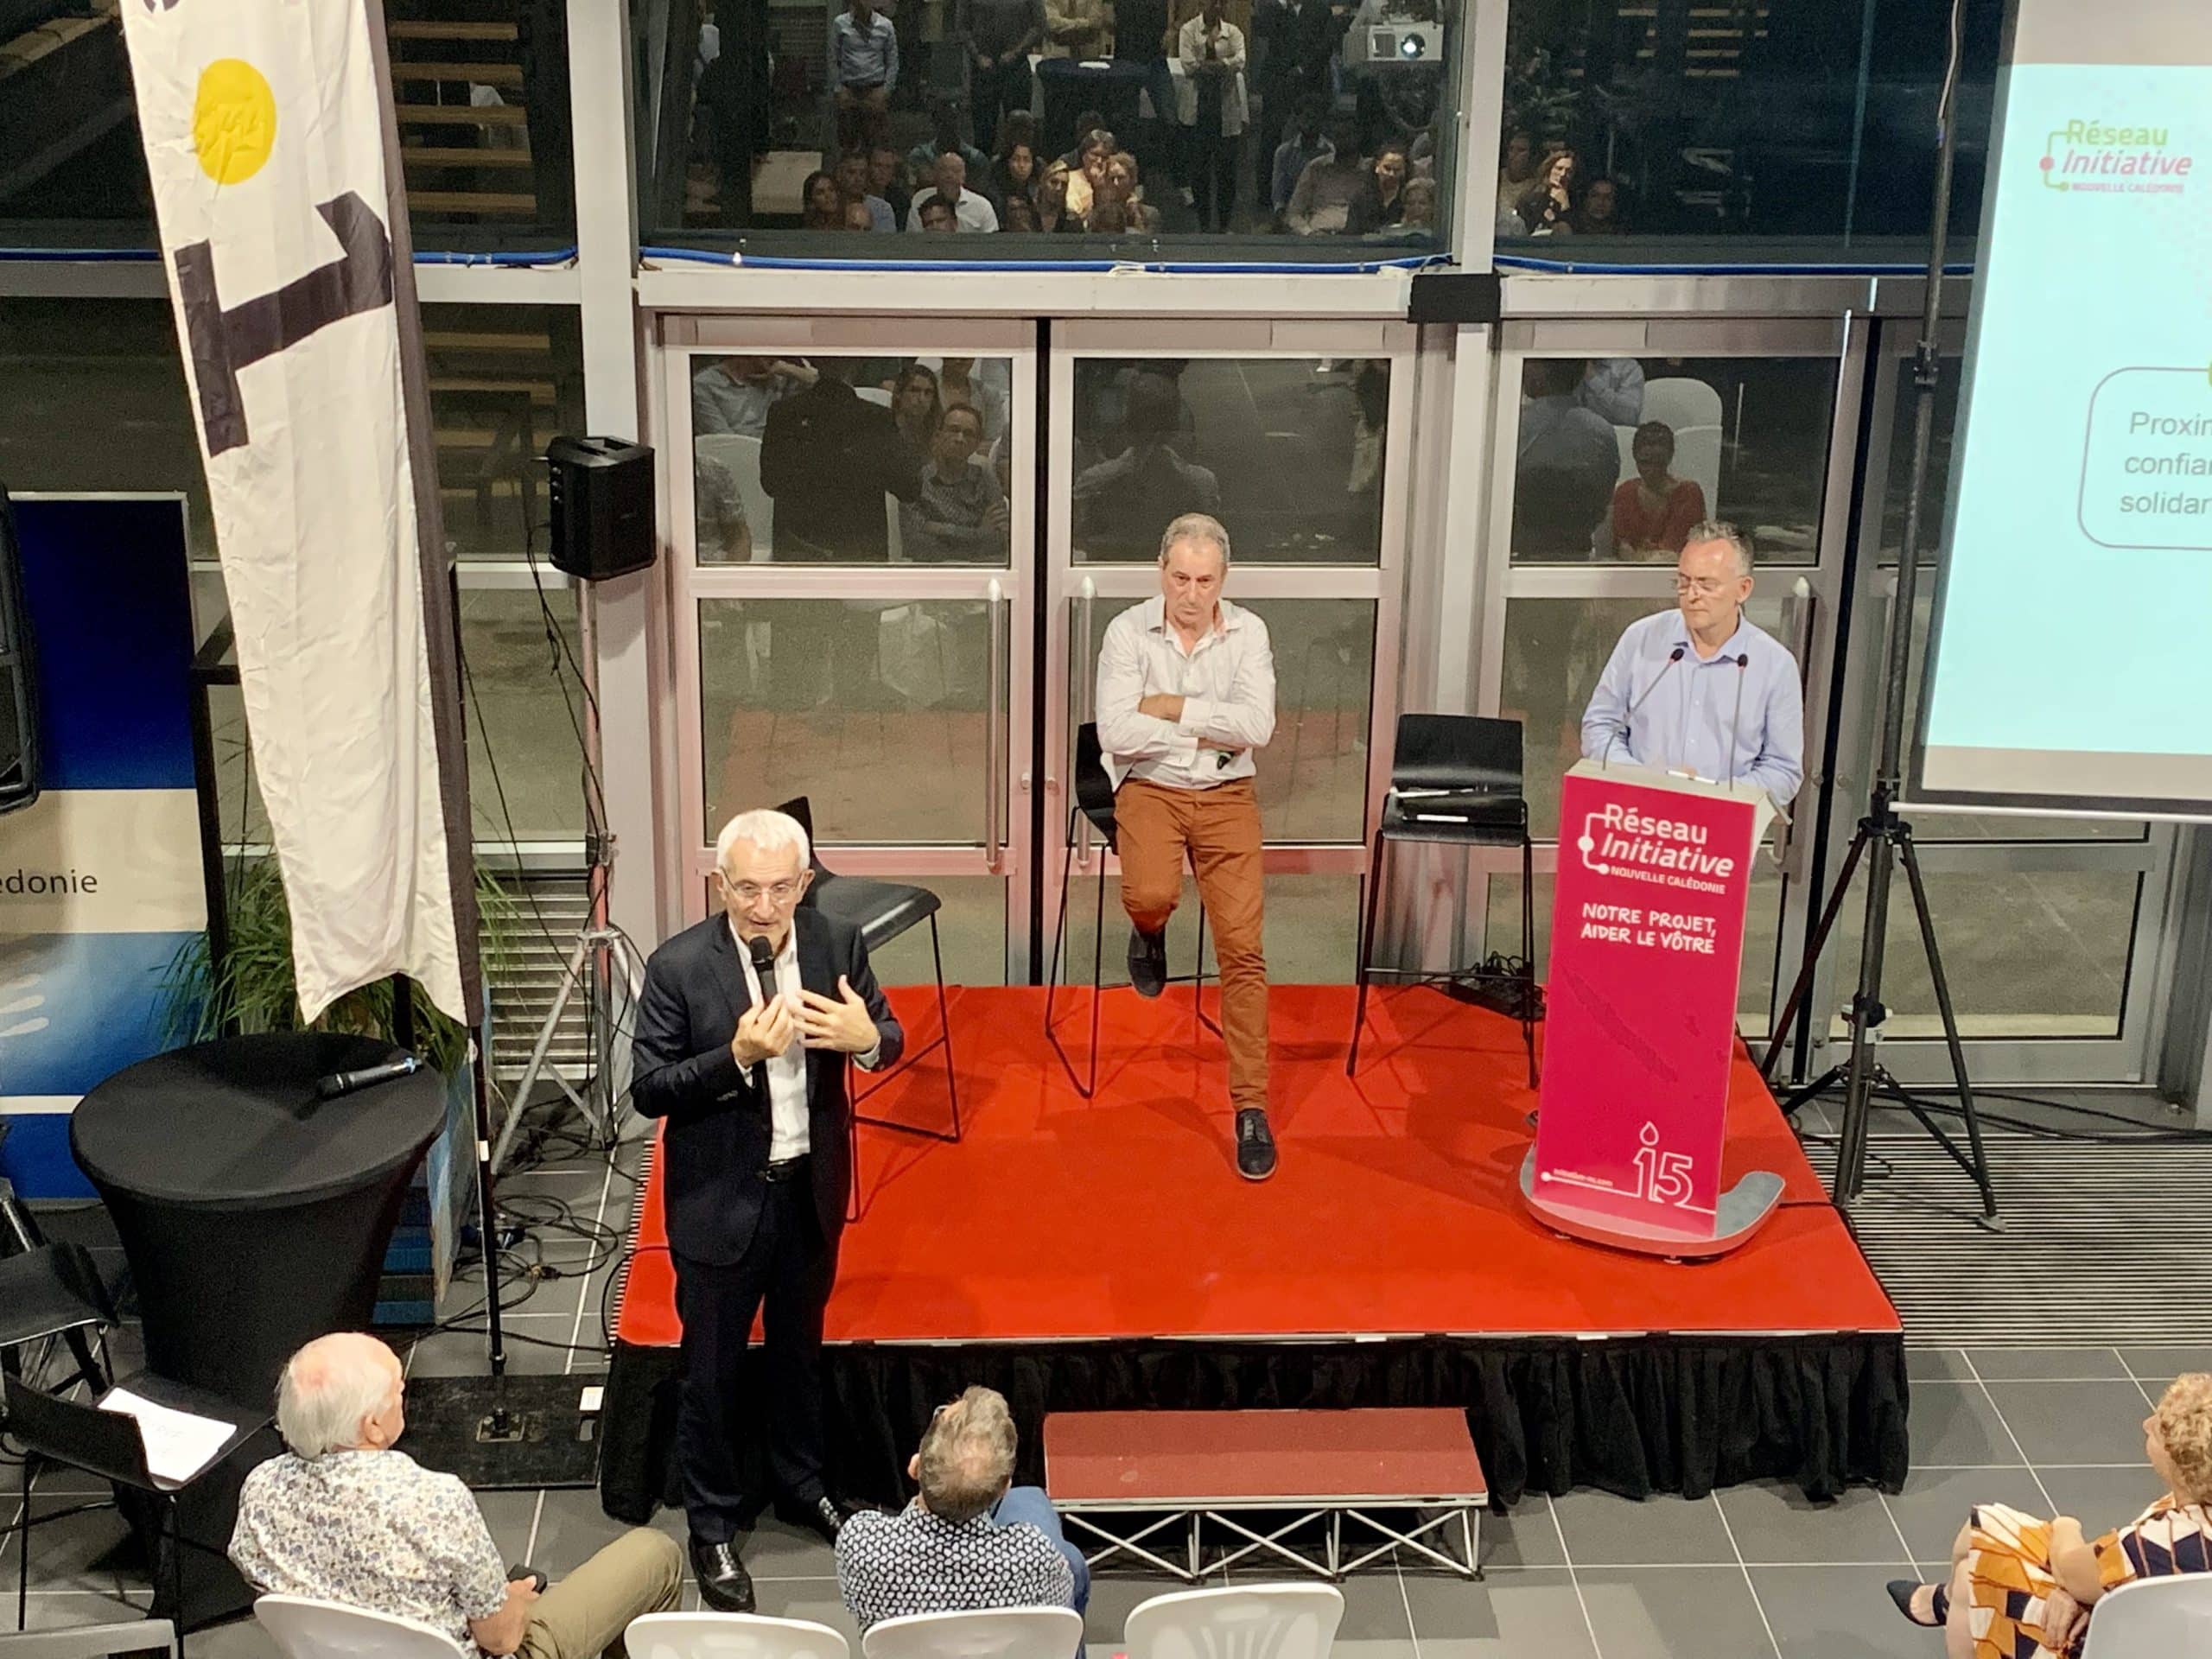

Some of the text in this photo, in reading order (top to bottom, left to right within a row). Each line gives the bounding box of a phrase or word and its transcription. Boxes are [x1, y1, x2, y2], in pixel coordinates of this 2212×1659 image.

[2066, 119, 2168, 145] Réseau
[2063, 149, 2193, 175] Initiative
[2125, 452, 2212, 475] confia
[1605, 803, 1707, 845] Réseau
[1600, 832, 1734, 878] Initiative
[0, 868, 98, 894] donie
[1611, 866, 1726, 895] NOUVELLE CALÉDONIE
[1582, 903, 1717, 938] NOTRE PROJET,
[1580, 922, 1715, 955] AIDER LE VÔTRE
[1632, 1147, 1694, 1207] 15
